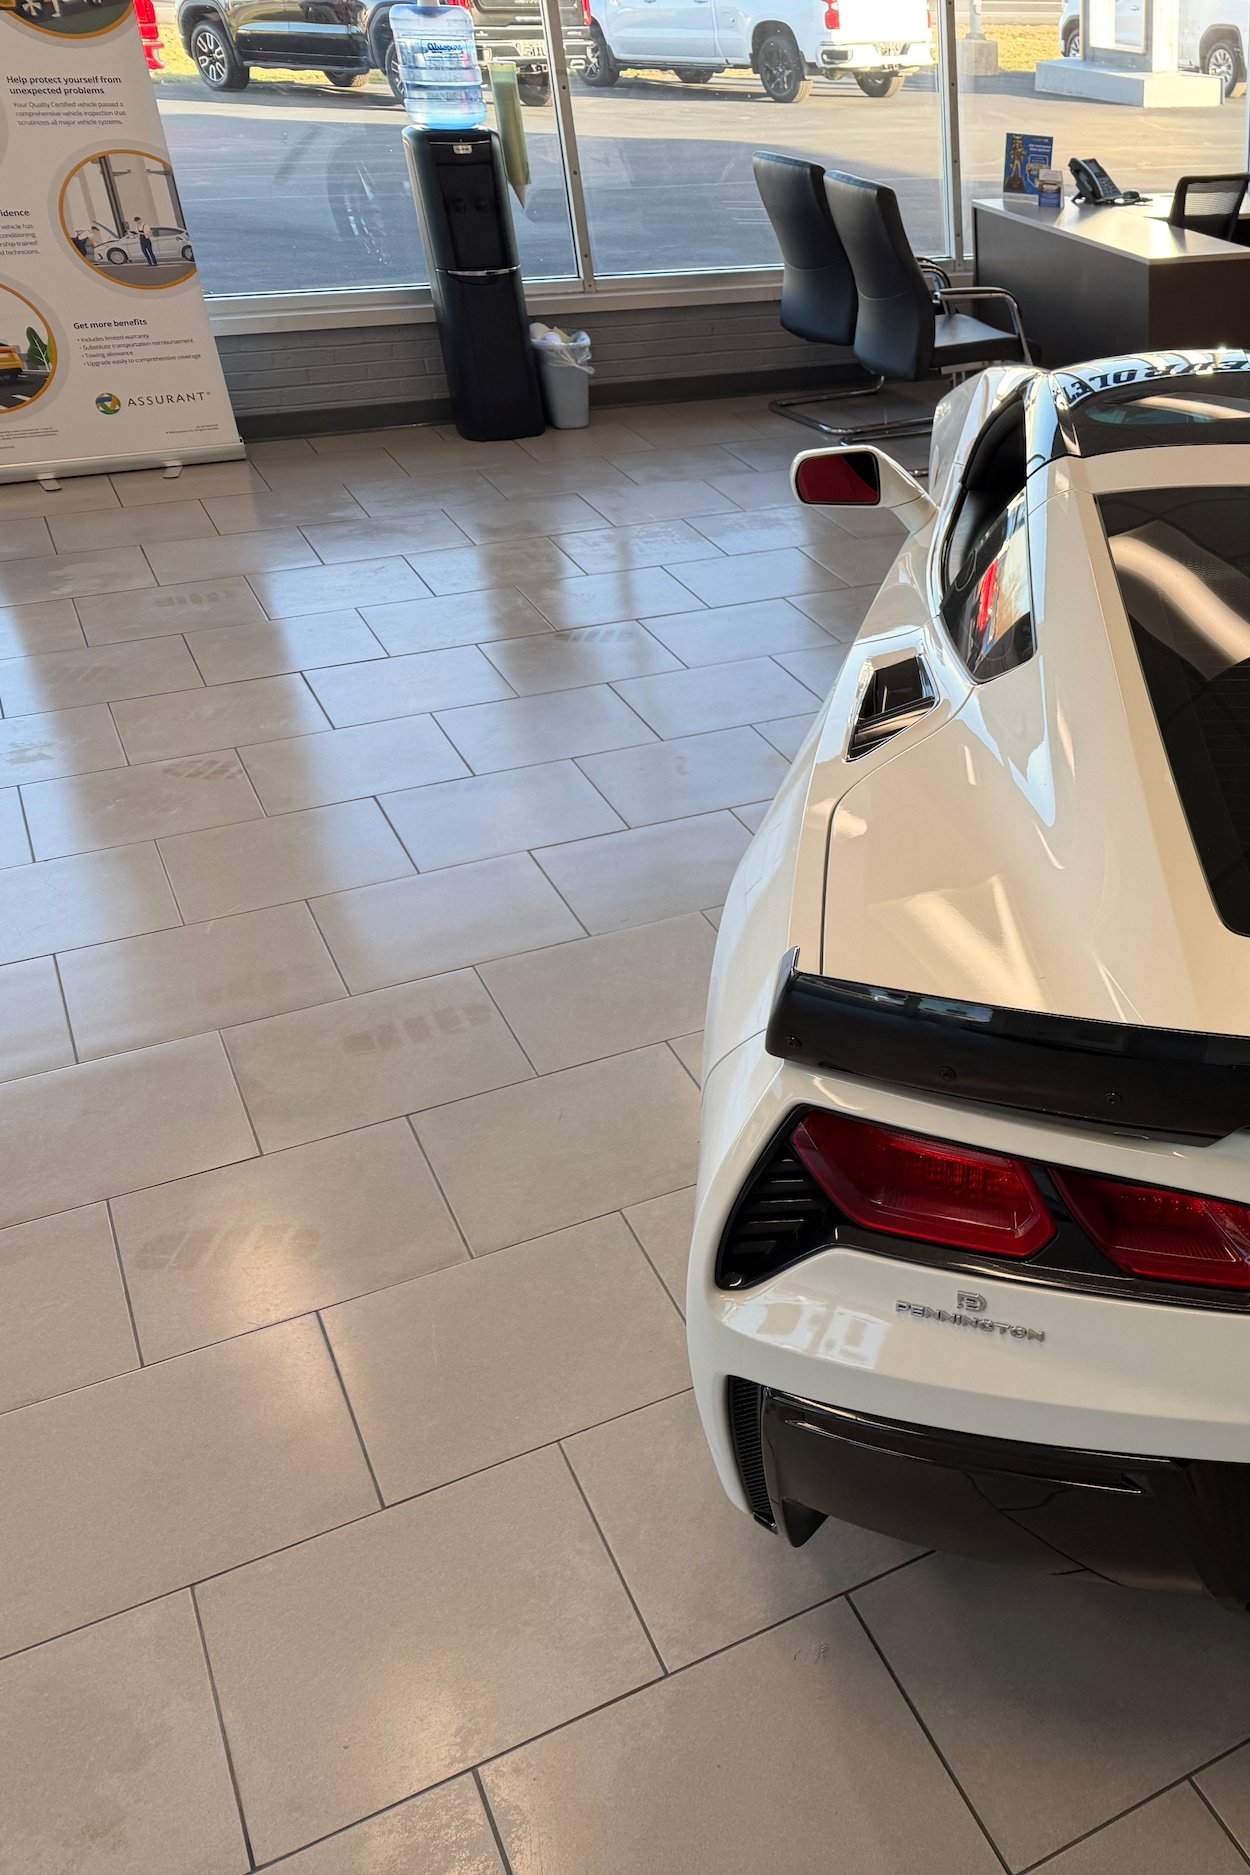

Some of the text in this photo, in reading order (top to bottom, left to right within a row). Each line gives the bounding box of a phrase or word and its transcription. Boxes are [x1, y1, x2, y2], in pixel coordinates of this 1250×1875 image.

[6, 76, 122, 85] Help protect yourself from
[9, 87, 105, 96] unexpected problems
[73, 318, 148, 330] Get more benefits
[112, 341, 152, 349] transportation
[135, 355, 177, 364] comprehensive
[127, 392, 205, 407] ASSURANT
[895, 1300, 1045, 1342] PENNINGTON
